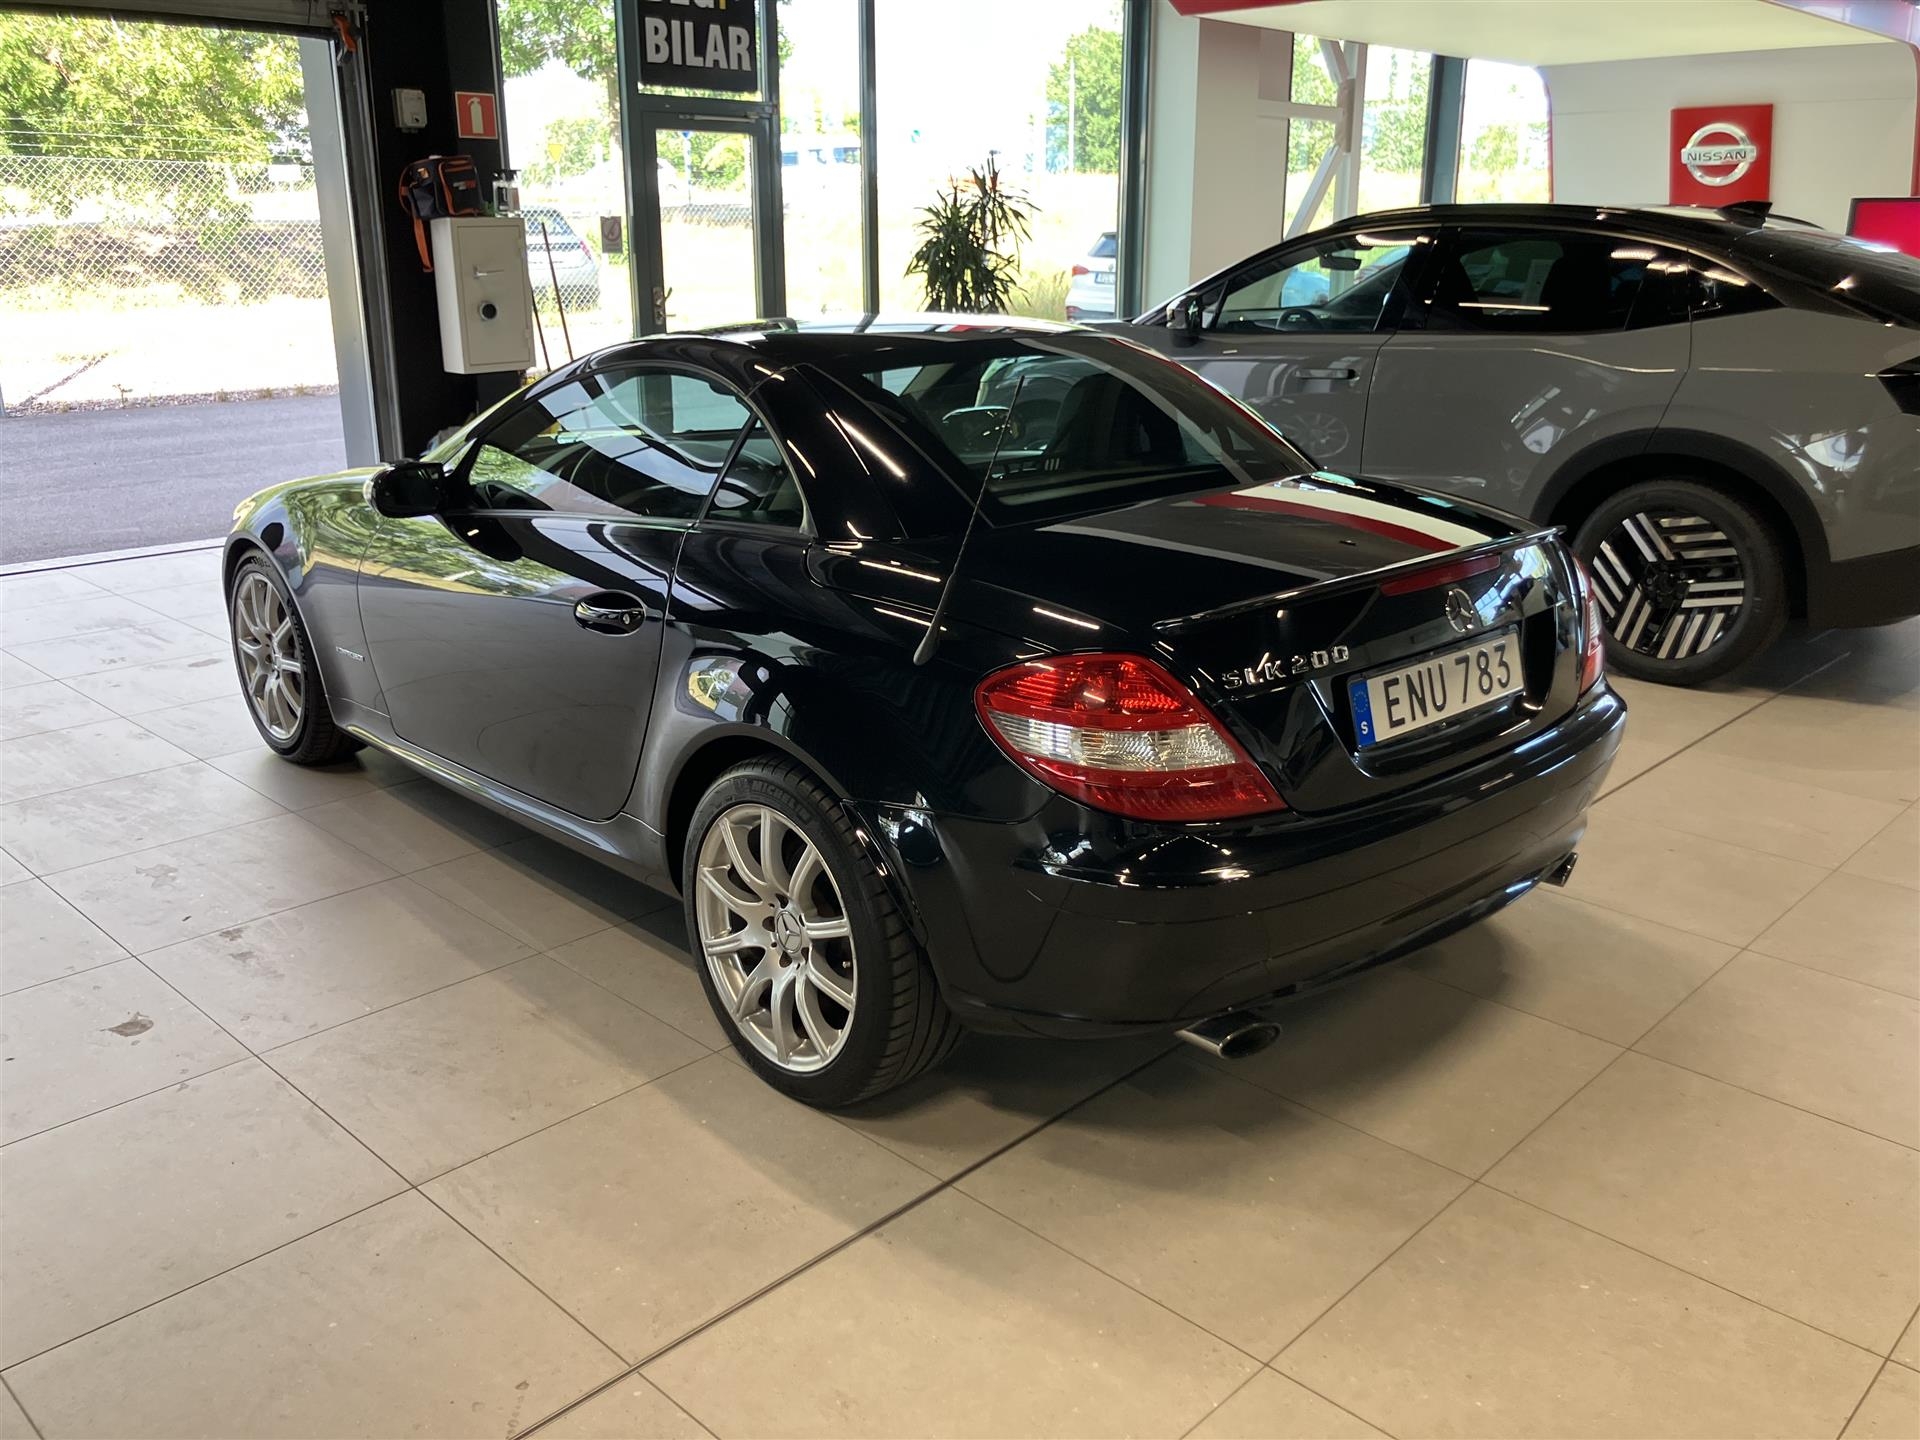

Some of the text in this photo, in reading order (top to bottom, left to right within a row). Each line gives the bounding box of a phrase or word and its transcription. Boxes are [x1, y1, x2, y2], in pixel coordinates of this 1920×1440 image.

[644, 17, 752, 71] BILAR
[1687, 151, 1747, 162] NISSAN
[1222, 645, 1349, 689] SLK 200
[1383, 642, 1511, 729] ENU 783
[1360, 721, 1369, 735] S
